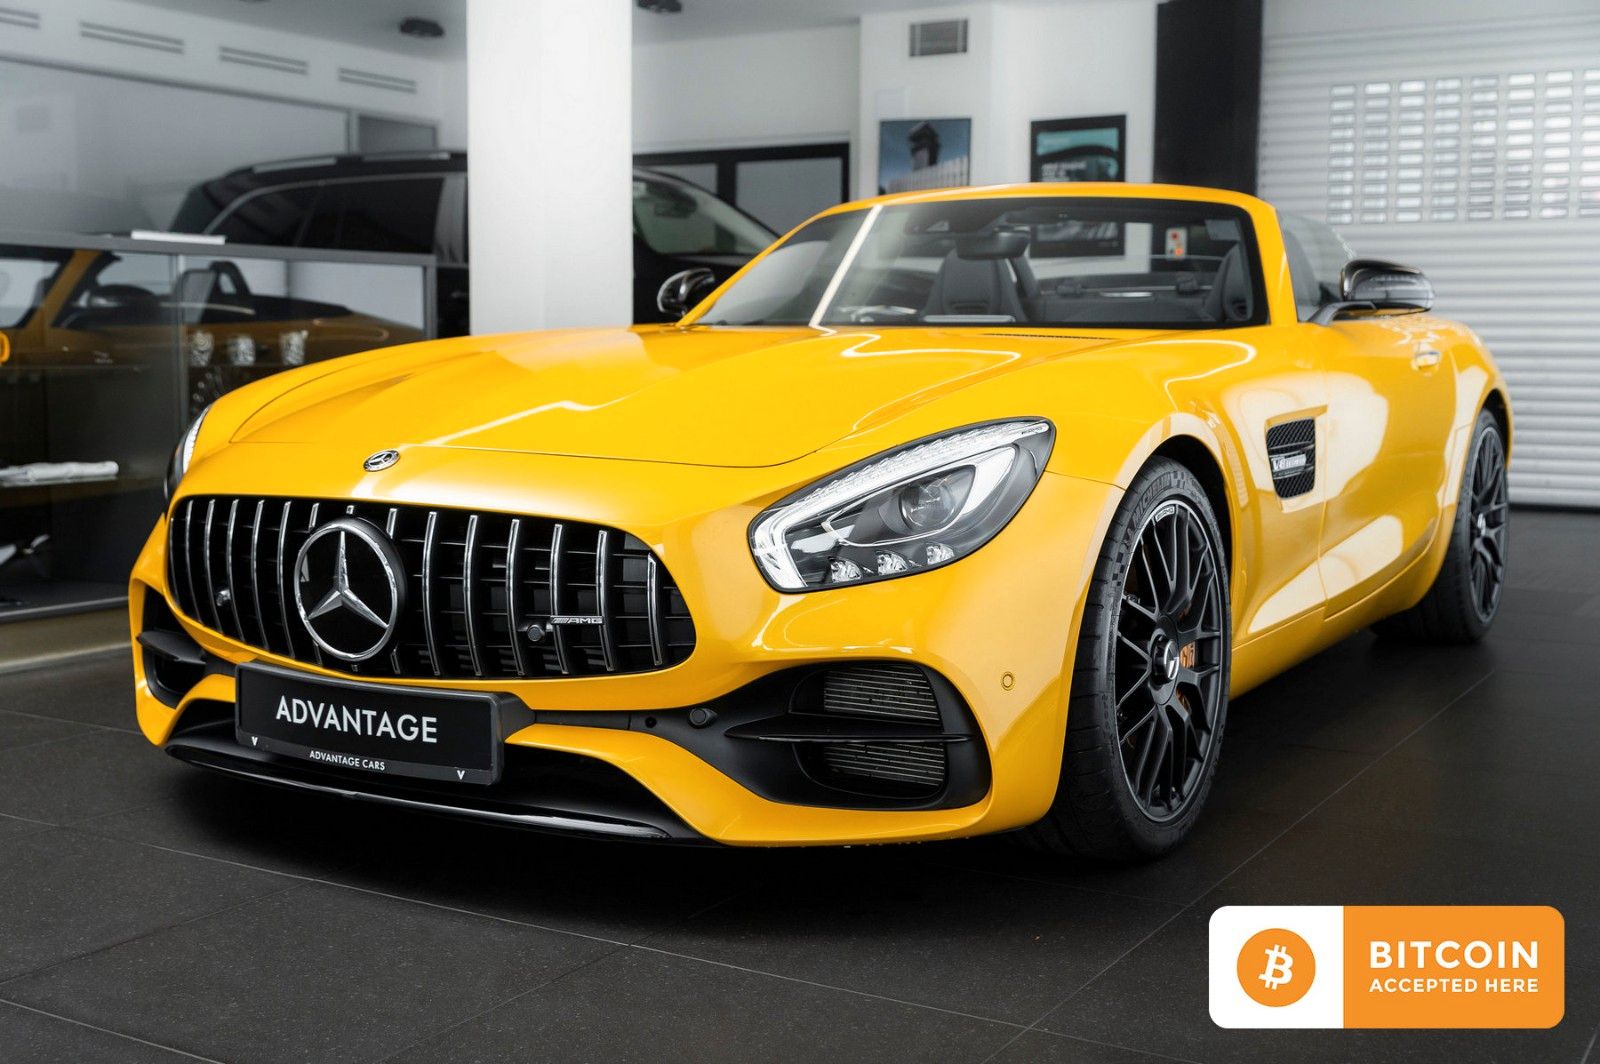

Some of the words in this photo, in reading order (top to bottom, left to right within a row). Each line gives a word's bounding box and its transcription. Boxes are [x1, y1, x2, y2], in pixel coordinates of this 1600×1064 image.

[275, 695, 438, 743] ADVANTAGE
[309, 750, 360, 767] ADVANTAGE
[362, 759, 386, 771] CARS
